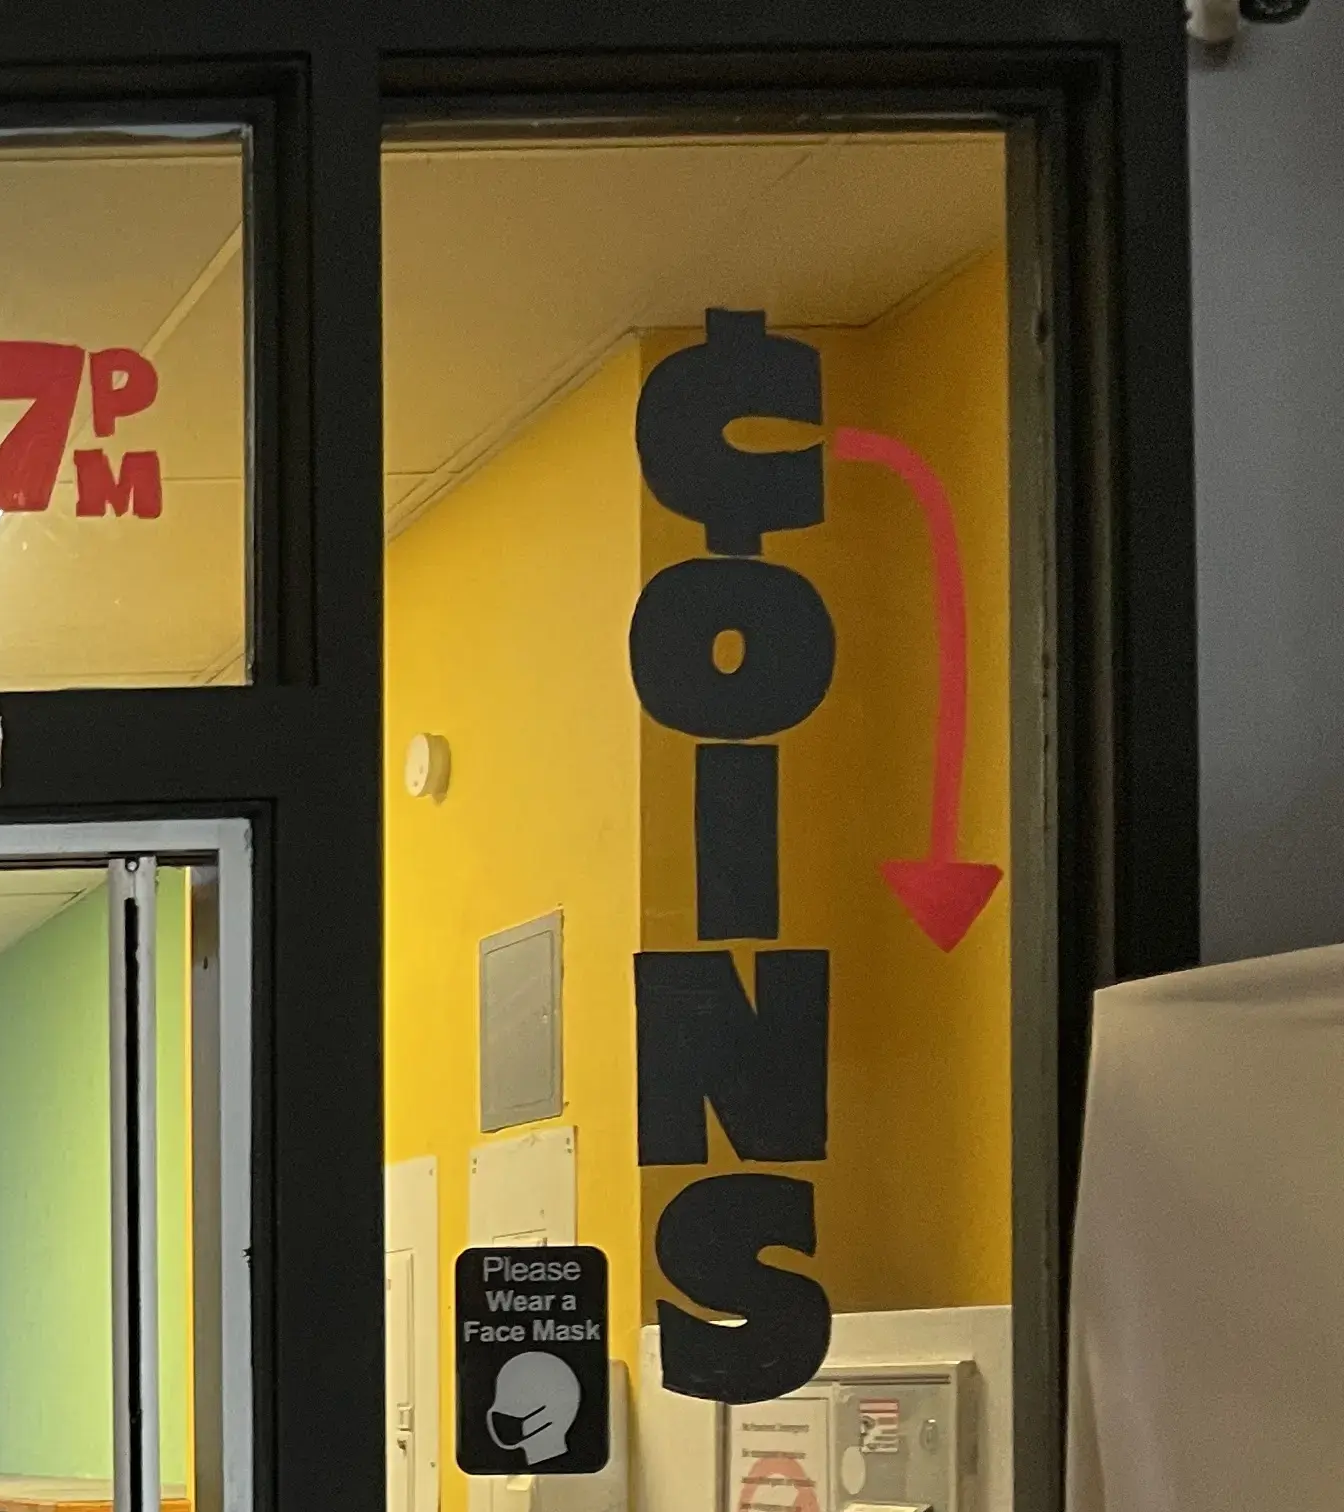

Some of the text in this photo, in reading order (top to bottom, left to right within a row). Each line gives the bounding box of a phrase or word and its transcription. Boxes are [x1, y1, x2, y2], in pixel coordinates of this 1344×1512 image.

[482, 1255, 582, 1283] Please
[485, 1289, 578, 1313] Wear a
[462, 1318, 602, 1343] Face Mask
